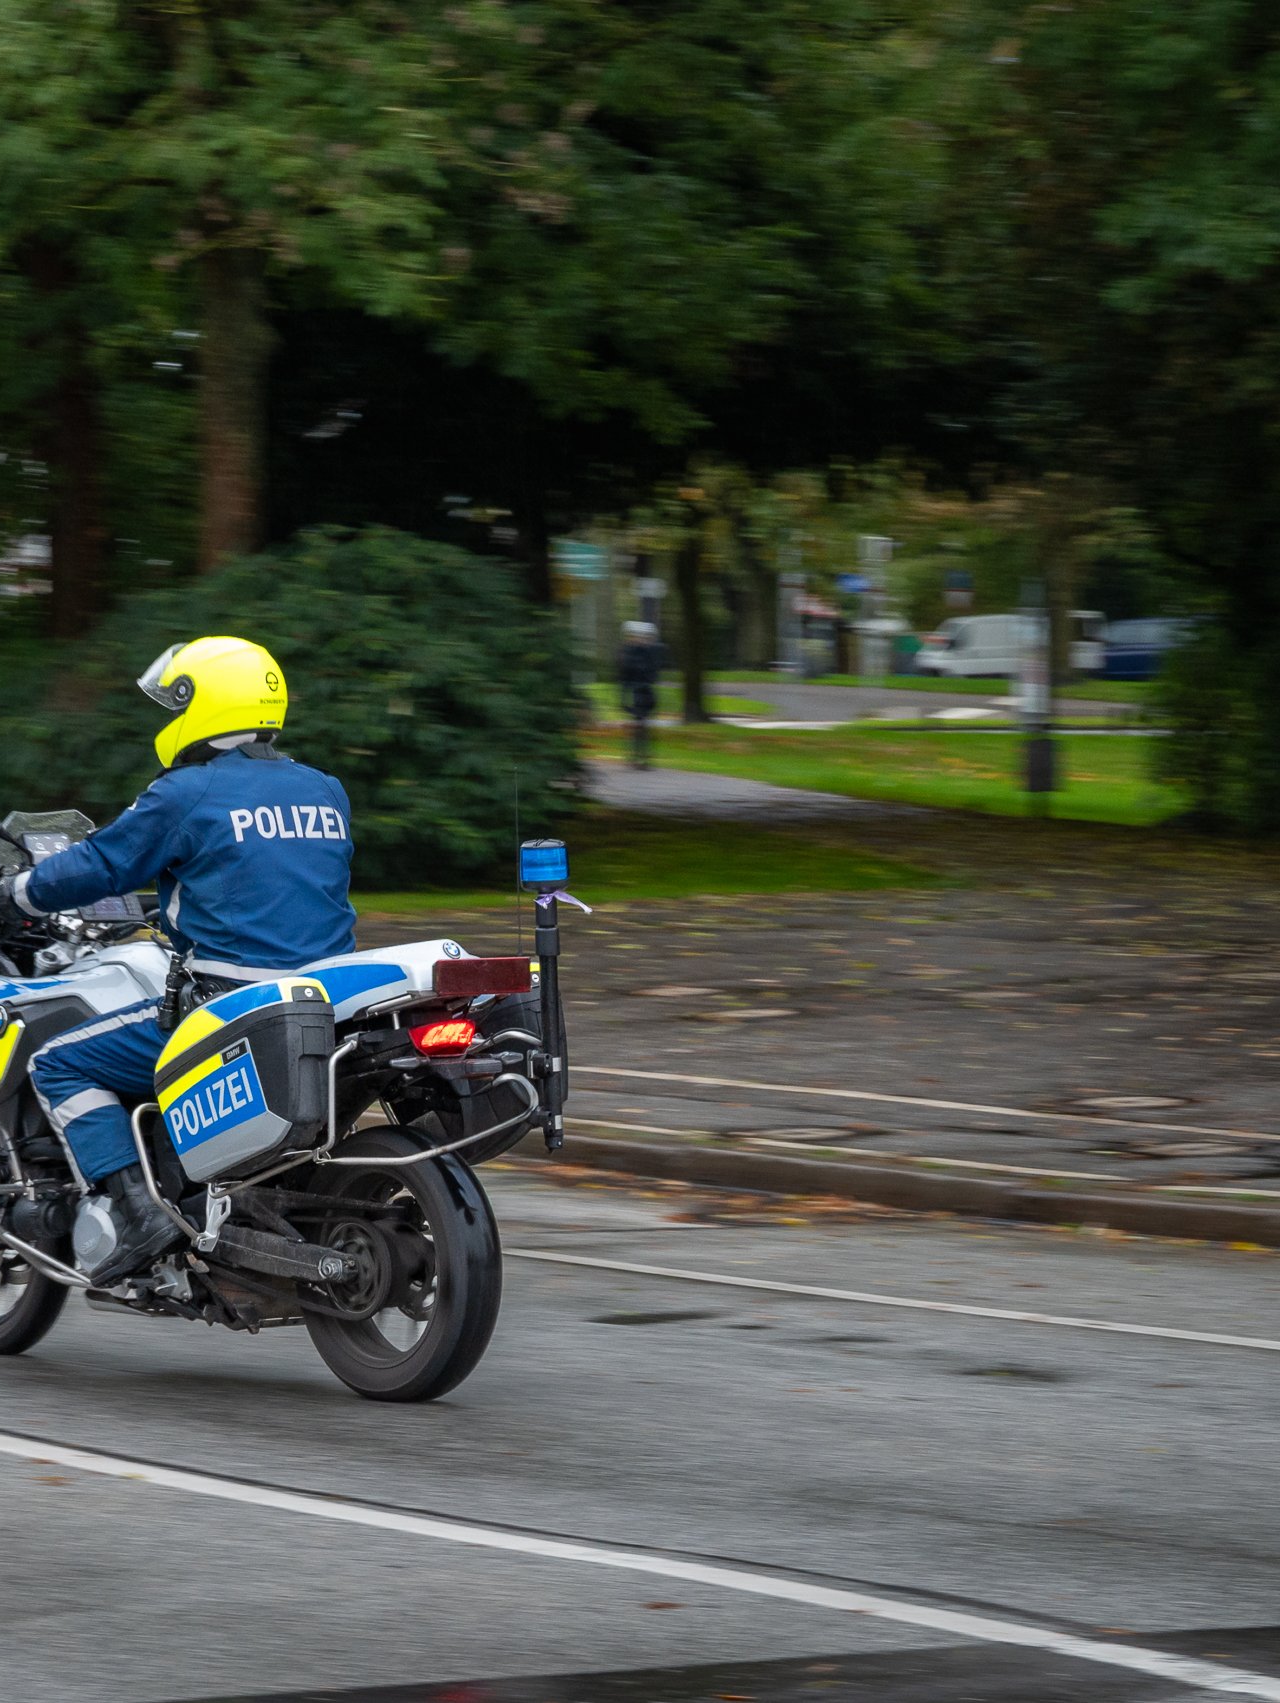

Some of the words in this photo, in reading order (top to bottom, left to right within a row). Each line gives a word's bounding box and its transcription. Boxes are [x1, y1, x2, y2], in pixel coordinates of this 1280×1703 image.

[229, 805, 347, 843] POLIZEI
[226, 1046, 240, 1060] BMW
[169, 1067, 254, 1145] POLIZEI
